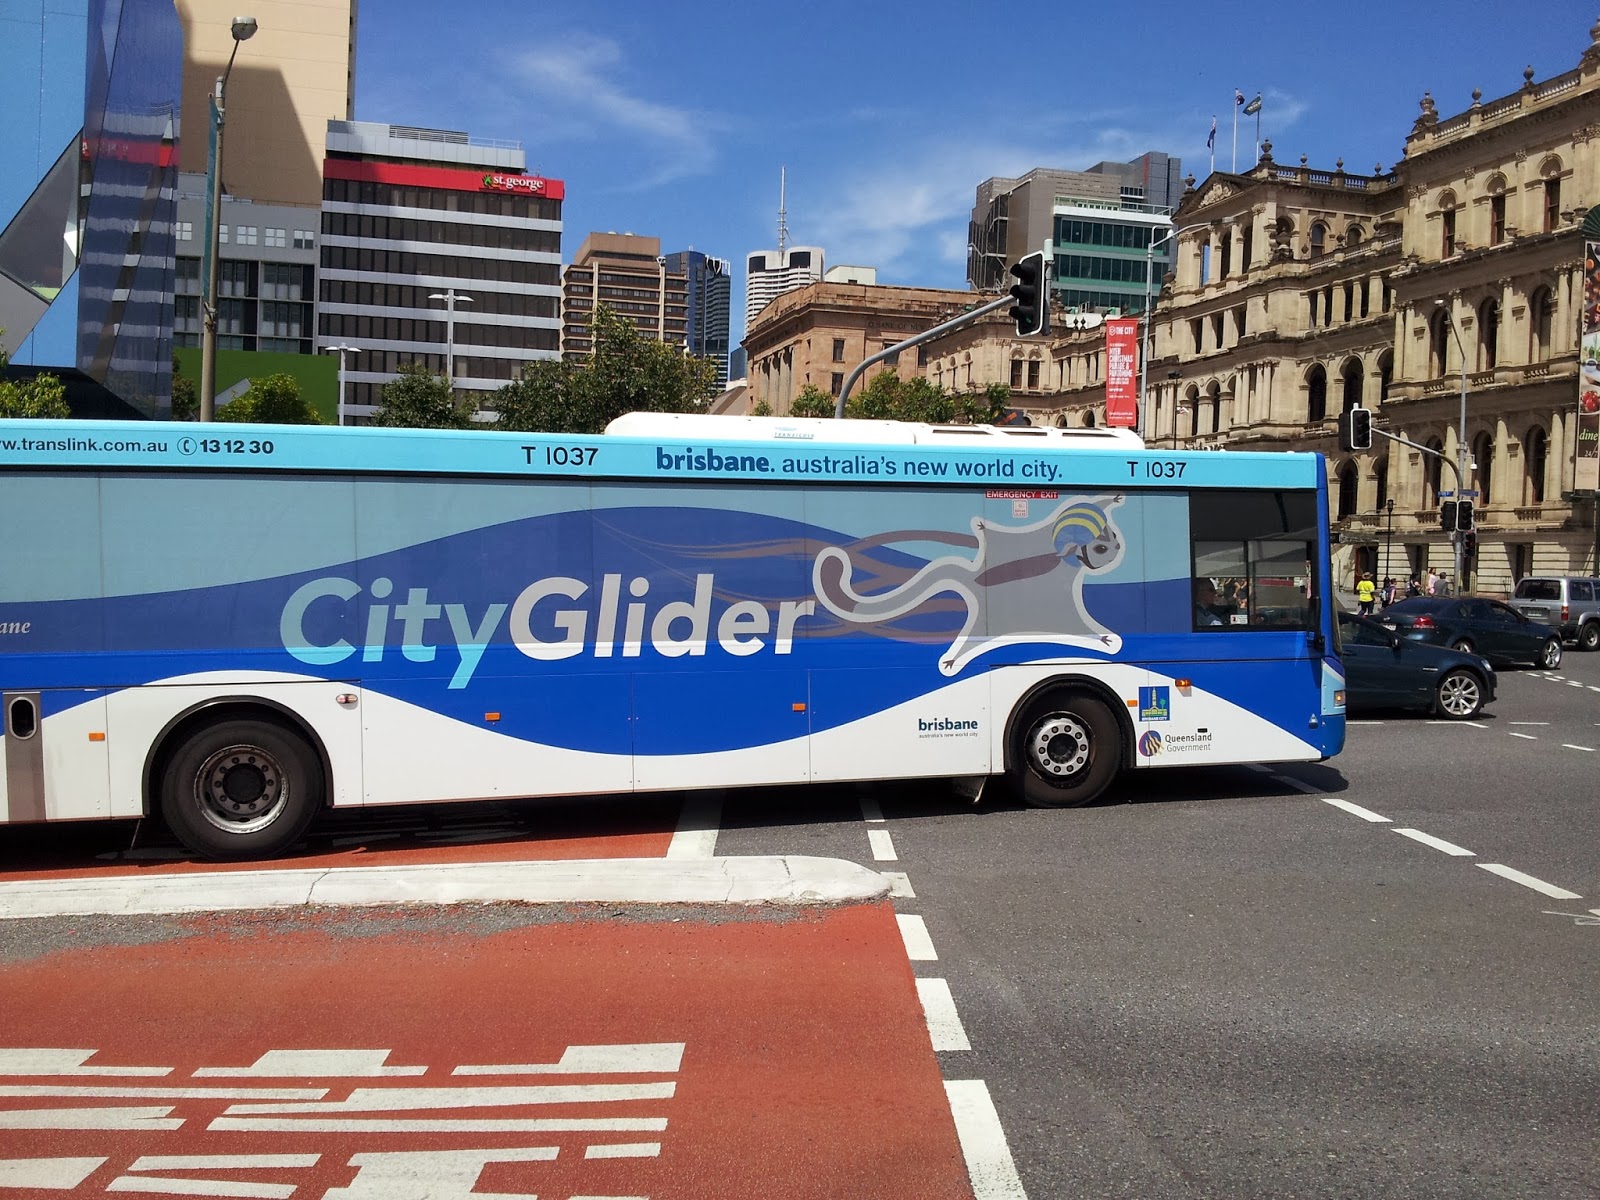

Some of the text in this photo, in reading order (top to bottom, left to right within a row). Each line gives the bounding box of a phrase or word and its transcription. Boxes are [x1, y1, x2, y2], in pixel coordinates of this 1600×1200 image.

[493, 175, 544, 191] st.george
[1124, 326, 1134, 335] CITY
[1579, 428, 1598, 441] dine
[0, 438, 168, 452] w.translink.com.au
[200, 439, 274, 454] 13 12 30
[521, 446, 599, 466] T 1037
[656, 446, 1063, 482] brisbane. australia’s new world city.
[1126, 461, 1187, 478] T 1037
[986, 490, 1058, 499] EMERGENCY EXIT
[0, 619, 31, 634] ane
[279, 573, 815, 690] CityGlider
[918, 717, 978, 731] brisbane
[1165, 733, 1212, 744] Queensland
[1166, 743, 1211, 752] Government
[0, 1042, 685, 1200] ANE
